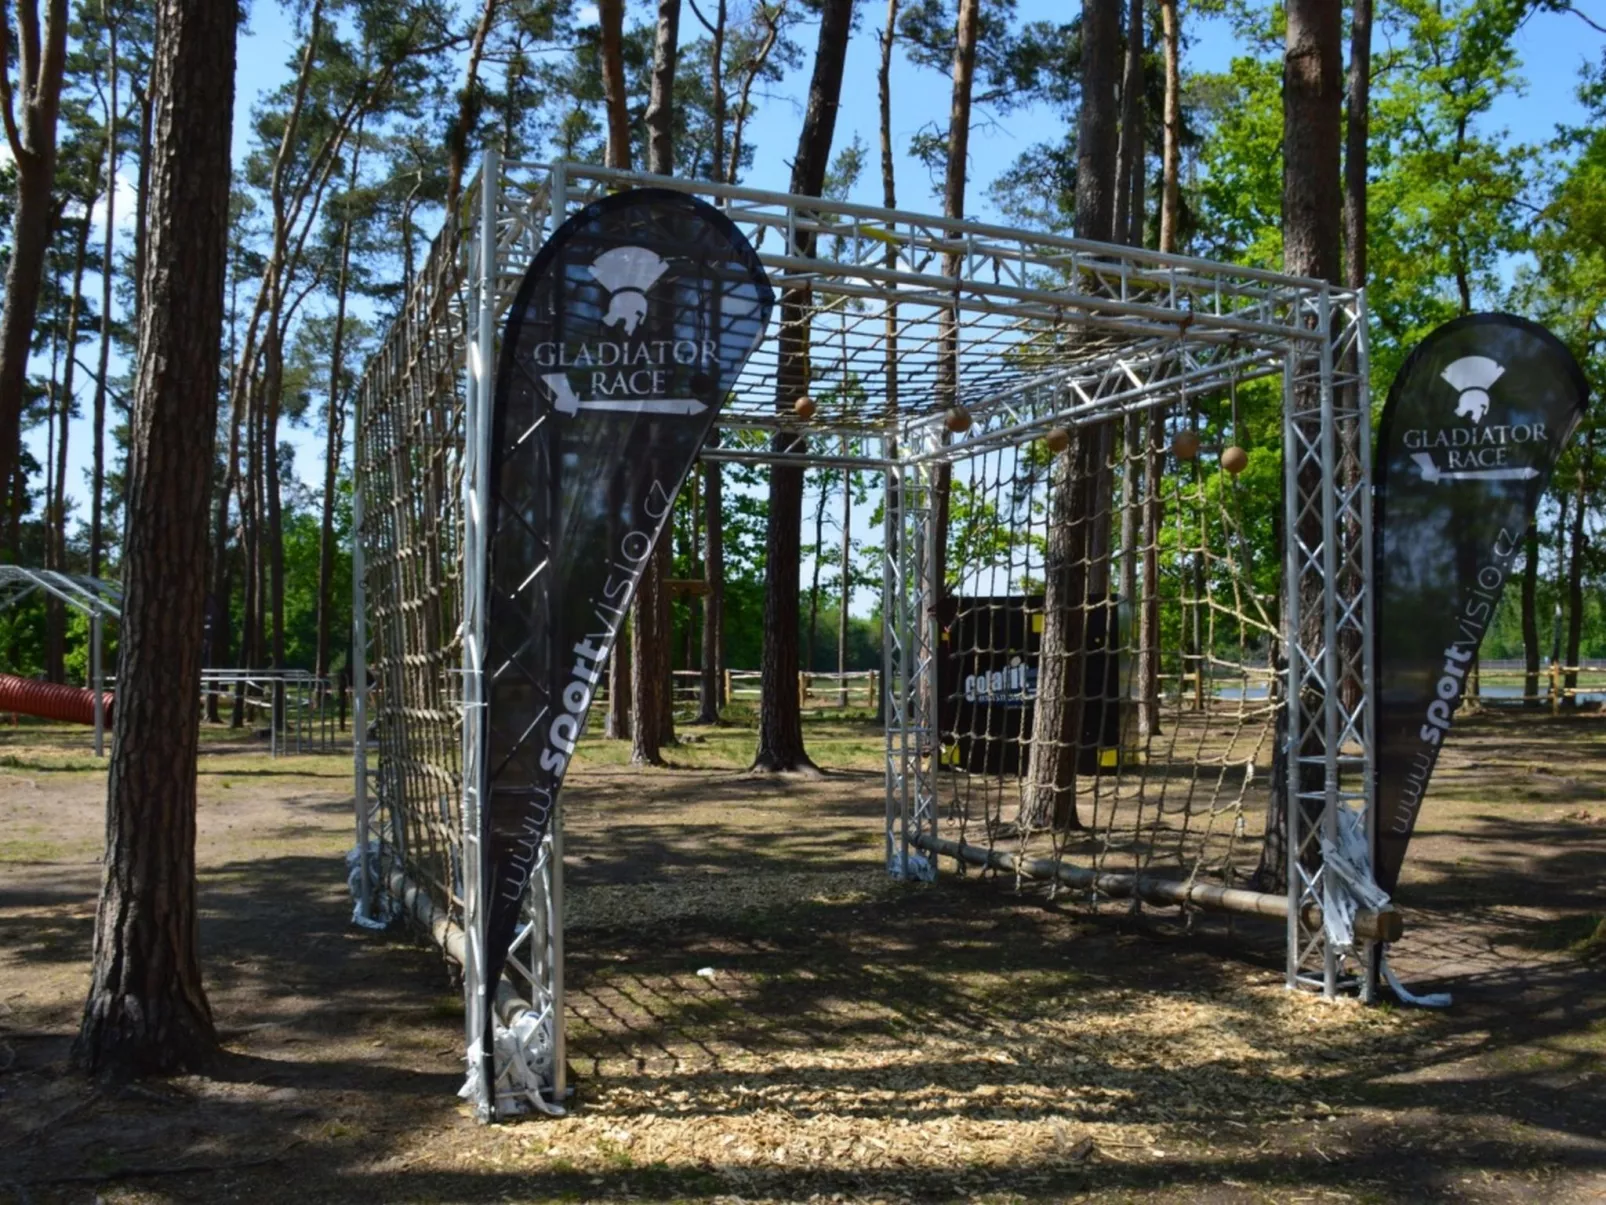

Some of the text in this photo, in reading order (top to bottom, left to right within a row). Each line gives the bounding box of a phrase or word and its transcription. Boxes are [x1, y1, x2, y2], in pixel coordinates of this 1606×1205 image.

[533, 340, 721, 367] GLADIATOR
[590, 371, 667, 396] RACE
[1402, 422, 1549, 449] GLADIATOR
[1448, 448, 1509, 469] RACE
[502, 479, 673, 903] www.sportvisio.cz
[1391, 527, 1520, 835] www.sportvisio.cz
